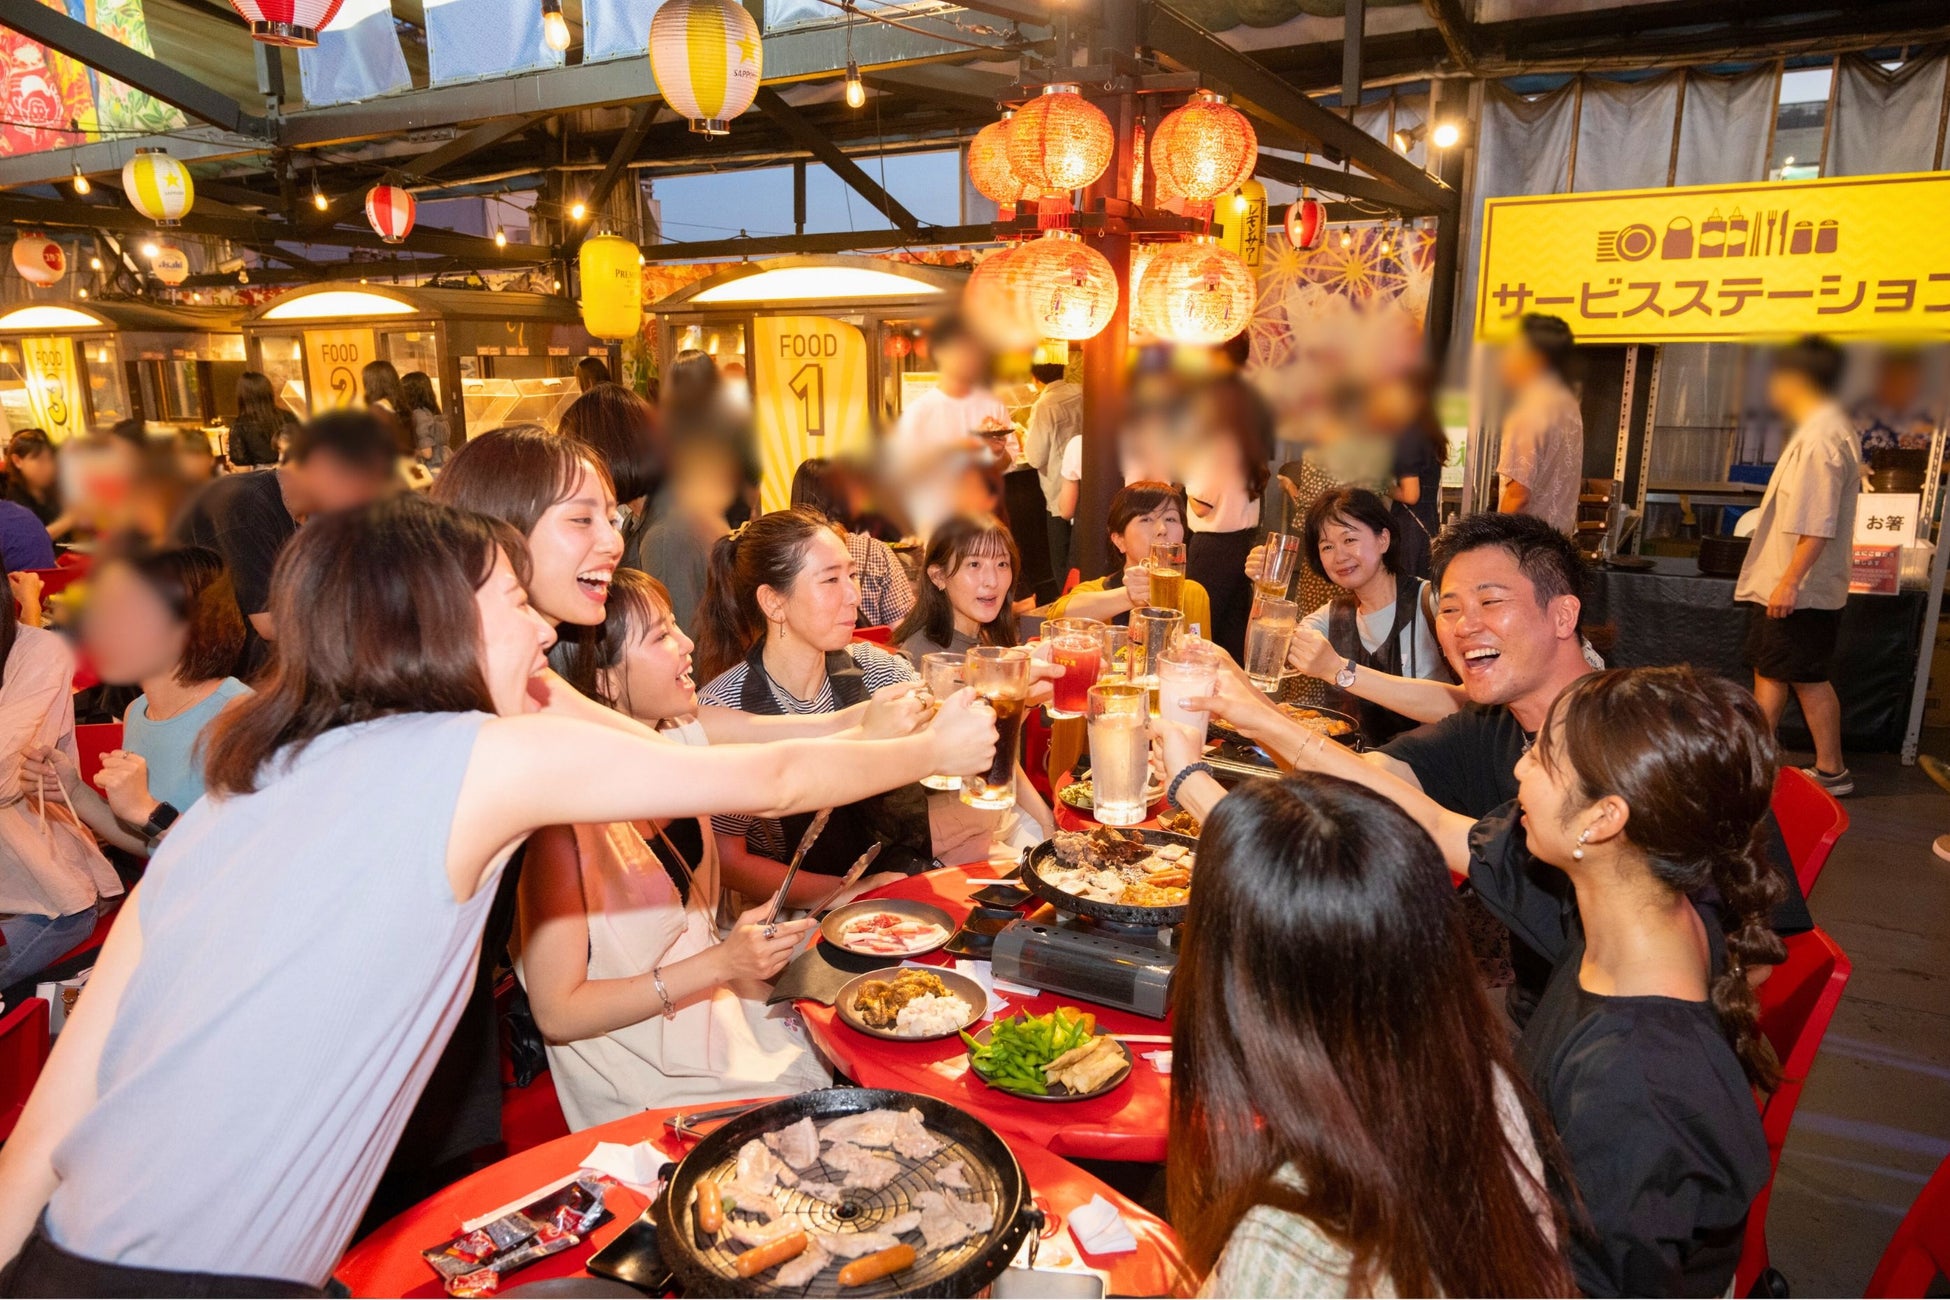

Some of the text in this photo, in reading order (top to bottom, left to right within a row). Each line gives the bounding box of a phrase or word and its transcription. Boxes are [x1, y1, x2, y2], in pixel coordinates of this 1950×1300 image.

[1244, 204, 1260, 262] レモンサワー
[36, 350, 63, 367] FOOD
[321, 344, 358, 363] FOOD
[780, 334, 837, 357] FOOD
[45, 372, 68, 426] 3
[330, 366, 358, 411] 2
[788, 363, 825, 437] 1
[1866, 515, 1905, 532] お箸
